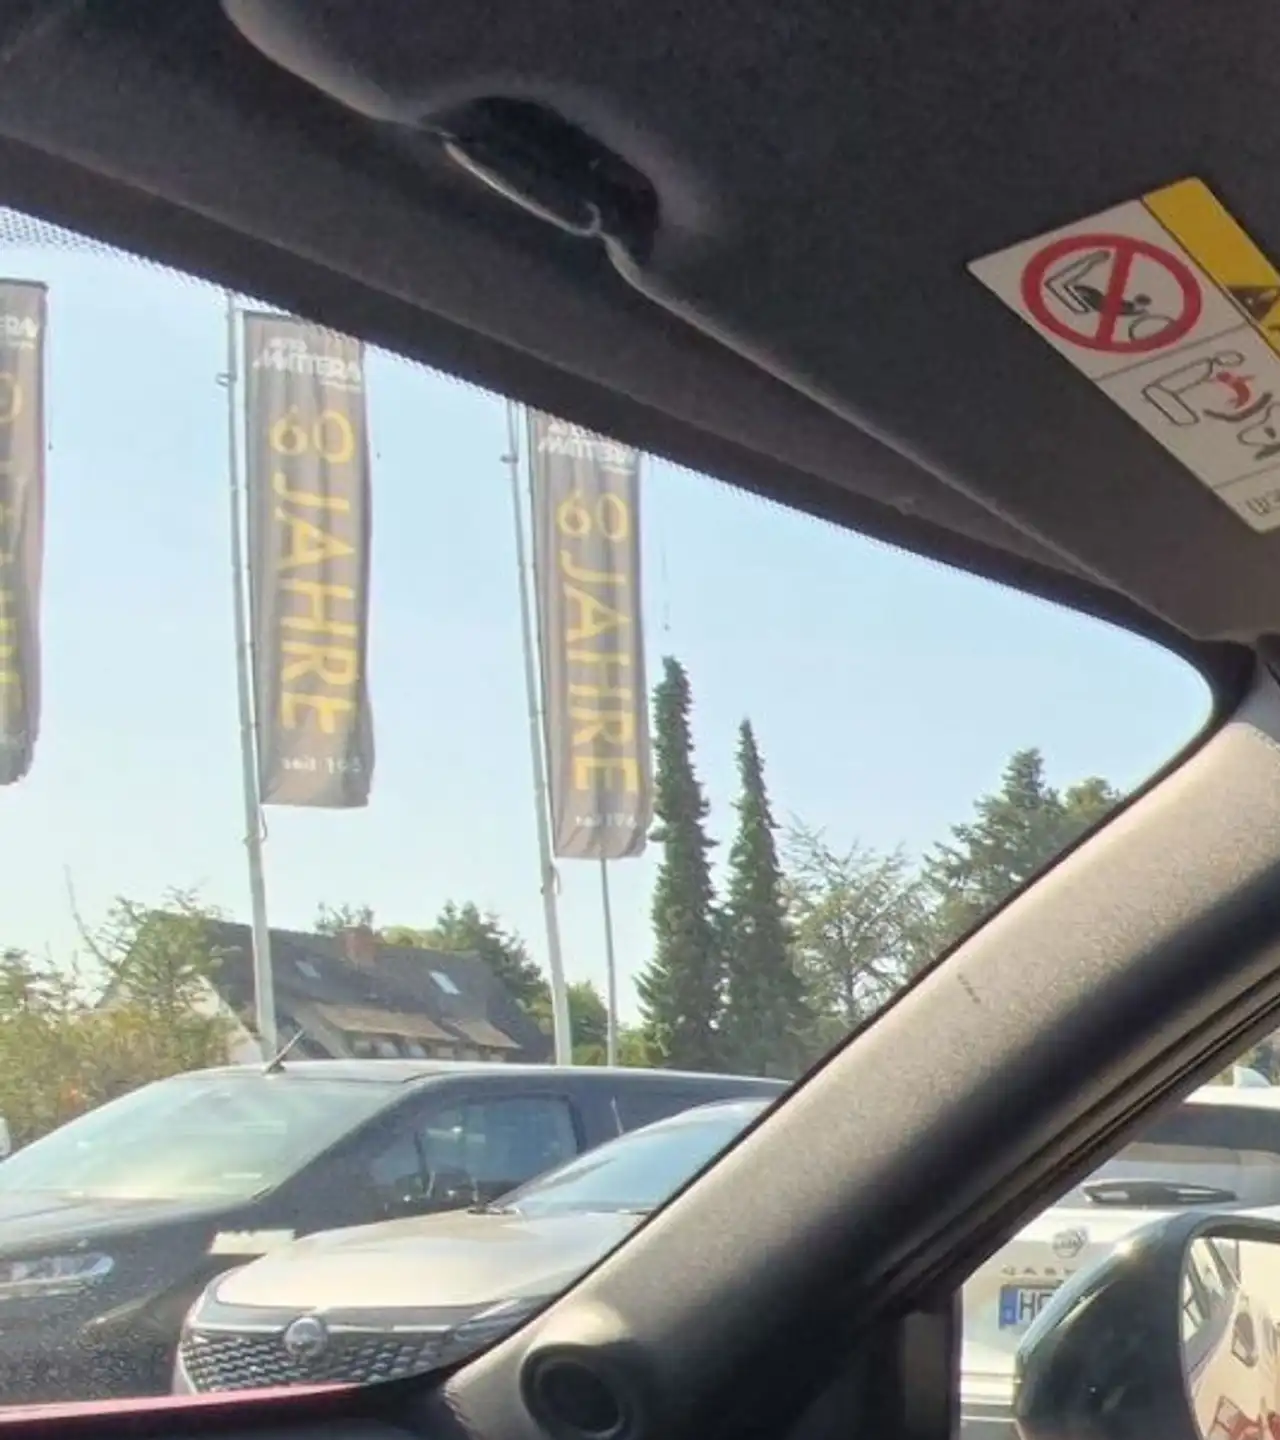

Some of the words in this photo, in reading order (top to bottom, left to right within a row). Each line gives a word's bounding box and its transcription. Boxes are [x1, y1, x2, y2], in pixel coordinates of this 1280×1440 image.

[269, 405, 355, 464] 60
[557, 491, 628, 543] 60
[273, 471, 359, 734] JAHRE
[560, 549, 641, 791] JAHRE
